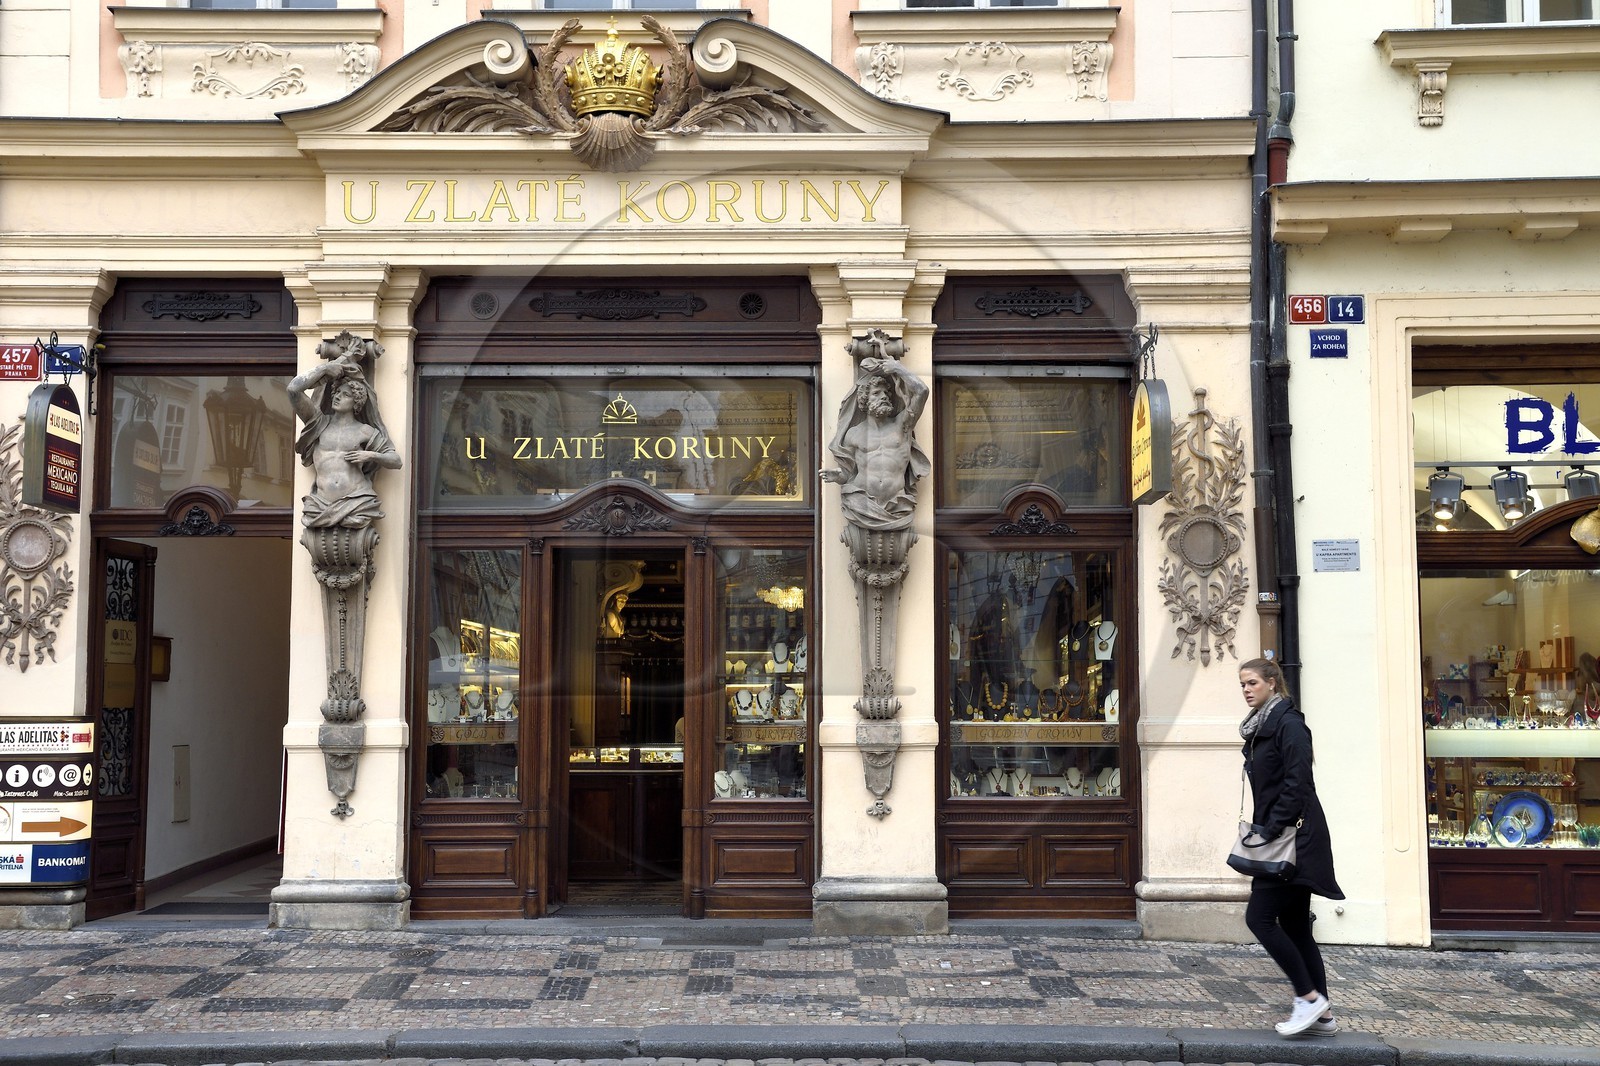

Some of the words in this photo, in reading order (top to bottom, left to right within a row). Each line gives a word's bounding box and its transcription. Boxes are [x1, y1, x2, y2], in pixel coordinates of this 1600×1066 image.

[341, 180, 380, 225] U
[404, 174, 586, 223] ZLATÉ
[616, 180, 890, 224] KORUNY
[1294, 298, 1322, 314] 456
[1337, 301, 1354, 317] 14
[1, 348, 32, 363] 457
[1503, 391, 1600, 457] BL
[465, 437, 487, 460] U
[513, 433, 606, 460] ZLATÉ
[633, 436, 776, 460] KORUNY
[51, 453, 76, 469] RESTAURANTE
[47, 464, 78, 484] MEXICANO
[50, 479, 66, 492] TEQUILA
[65, 484, 75, 495] BAR
[0, 731, 16, 744] LAS
[18, 730, 59, 744] ADELITAS
[979, 728, 1032, 740] GOLDEN
[1036, 728, 1084, 740] CROWN
[38, 856, 87, 867] BANKOMAT
